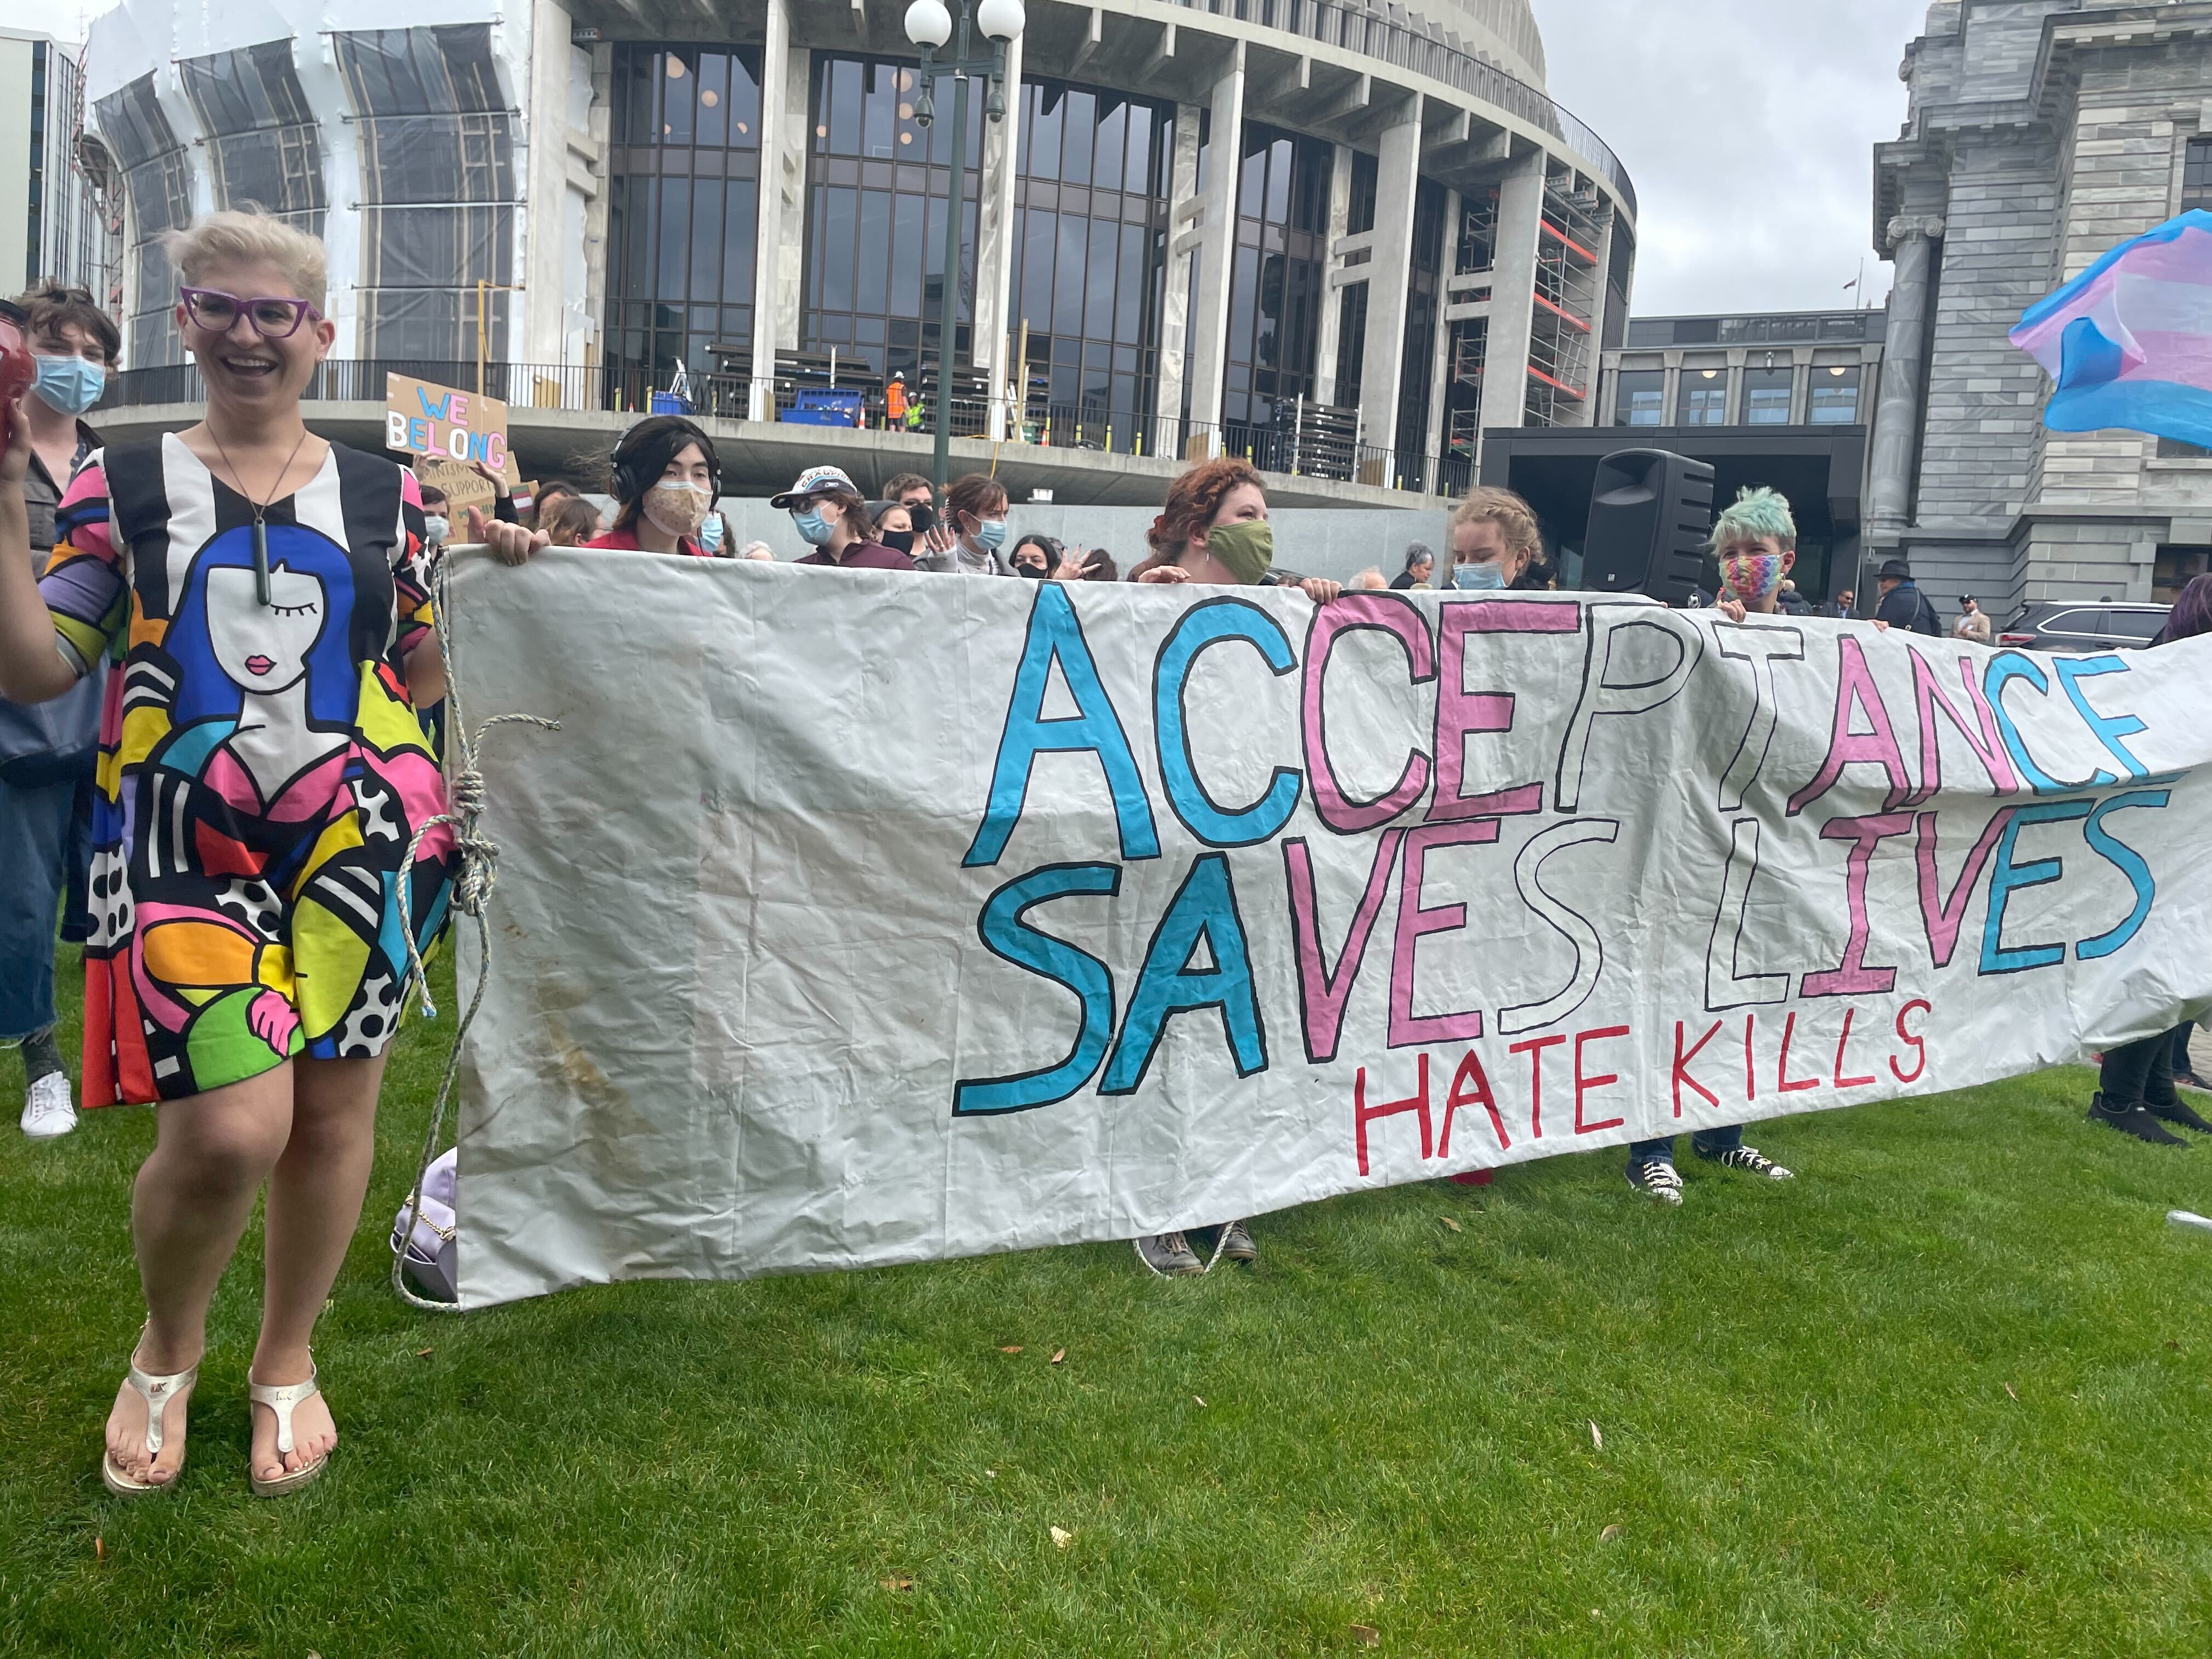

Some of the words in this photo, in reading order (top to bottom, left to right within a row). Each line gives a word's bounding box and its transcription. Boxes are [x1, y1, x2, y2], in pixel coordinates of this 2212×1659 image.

[416, 386, 469, 426] WE
[388, 410, 506, 469] BELONG
[424, 463, 469, 480] MINISM
[441, 479, 495, 499] SUPPORT
[961, 580, 2191, 868] ACCEPTANCE
[952, 817, 1619, 1116] SAVES
[1705, 789, 2171, 1012] LIVES
[1355, 1025, 1629, 1177] HATE
[1673, 998, 1932, 1118] KILLS
